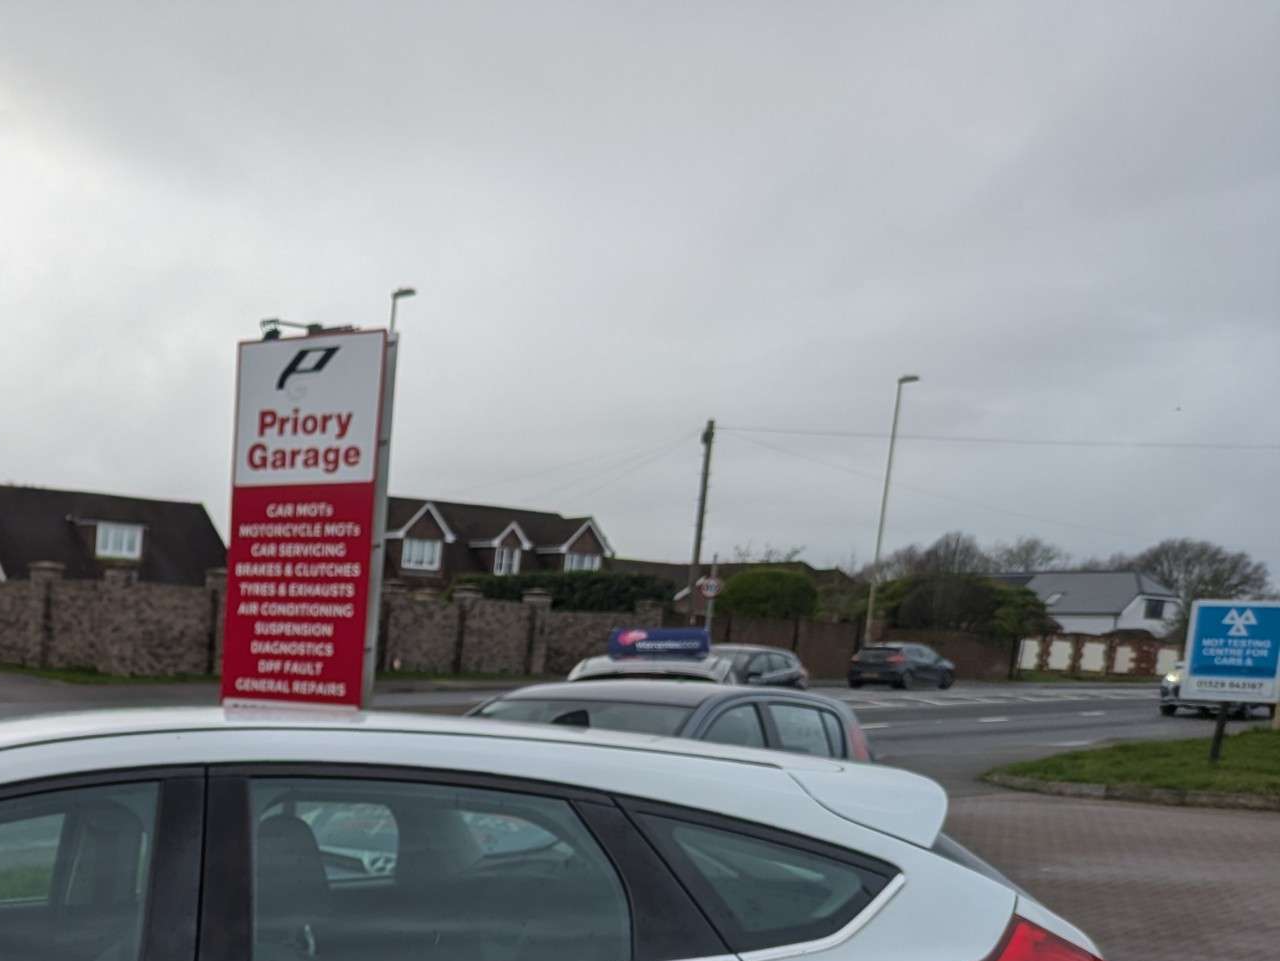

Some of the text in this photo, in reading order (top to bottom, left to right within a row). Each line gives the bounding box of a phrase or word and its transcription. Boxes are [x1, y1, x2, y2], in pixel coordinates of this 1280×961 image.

[257, 409, 353, 439] Priory
[247, 443, 362, 473] Garage
[266, 502, 333, 517] CAR MOTs
[239, 522, 361, 538] MOTORCYCLE MOTs
[250, 542, 347, 557] CAR SERVICING
[235, 563, 361, 577] BRAKES & CLUTCHES
[239, 583, 355, 598] TYRES & EXHAUSTS
[237, 602, 354, 617] AIR CONDITIONING
[254, 622, 334, 637] SUSPENSION
[250, 641, 334, 657] DIAGNOSTICS
[283, 660, 323, 675] FAULT
[235, 677, 346, 697] GENERAL REPAIRS
